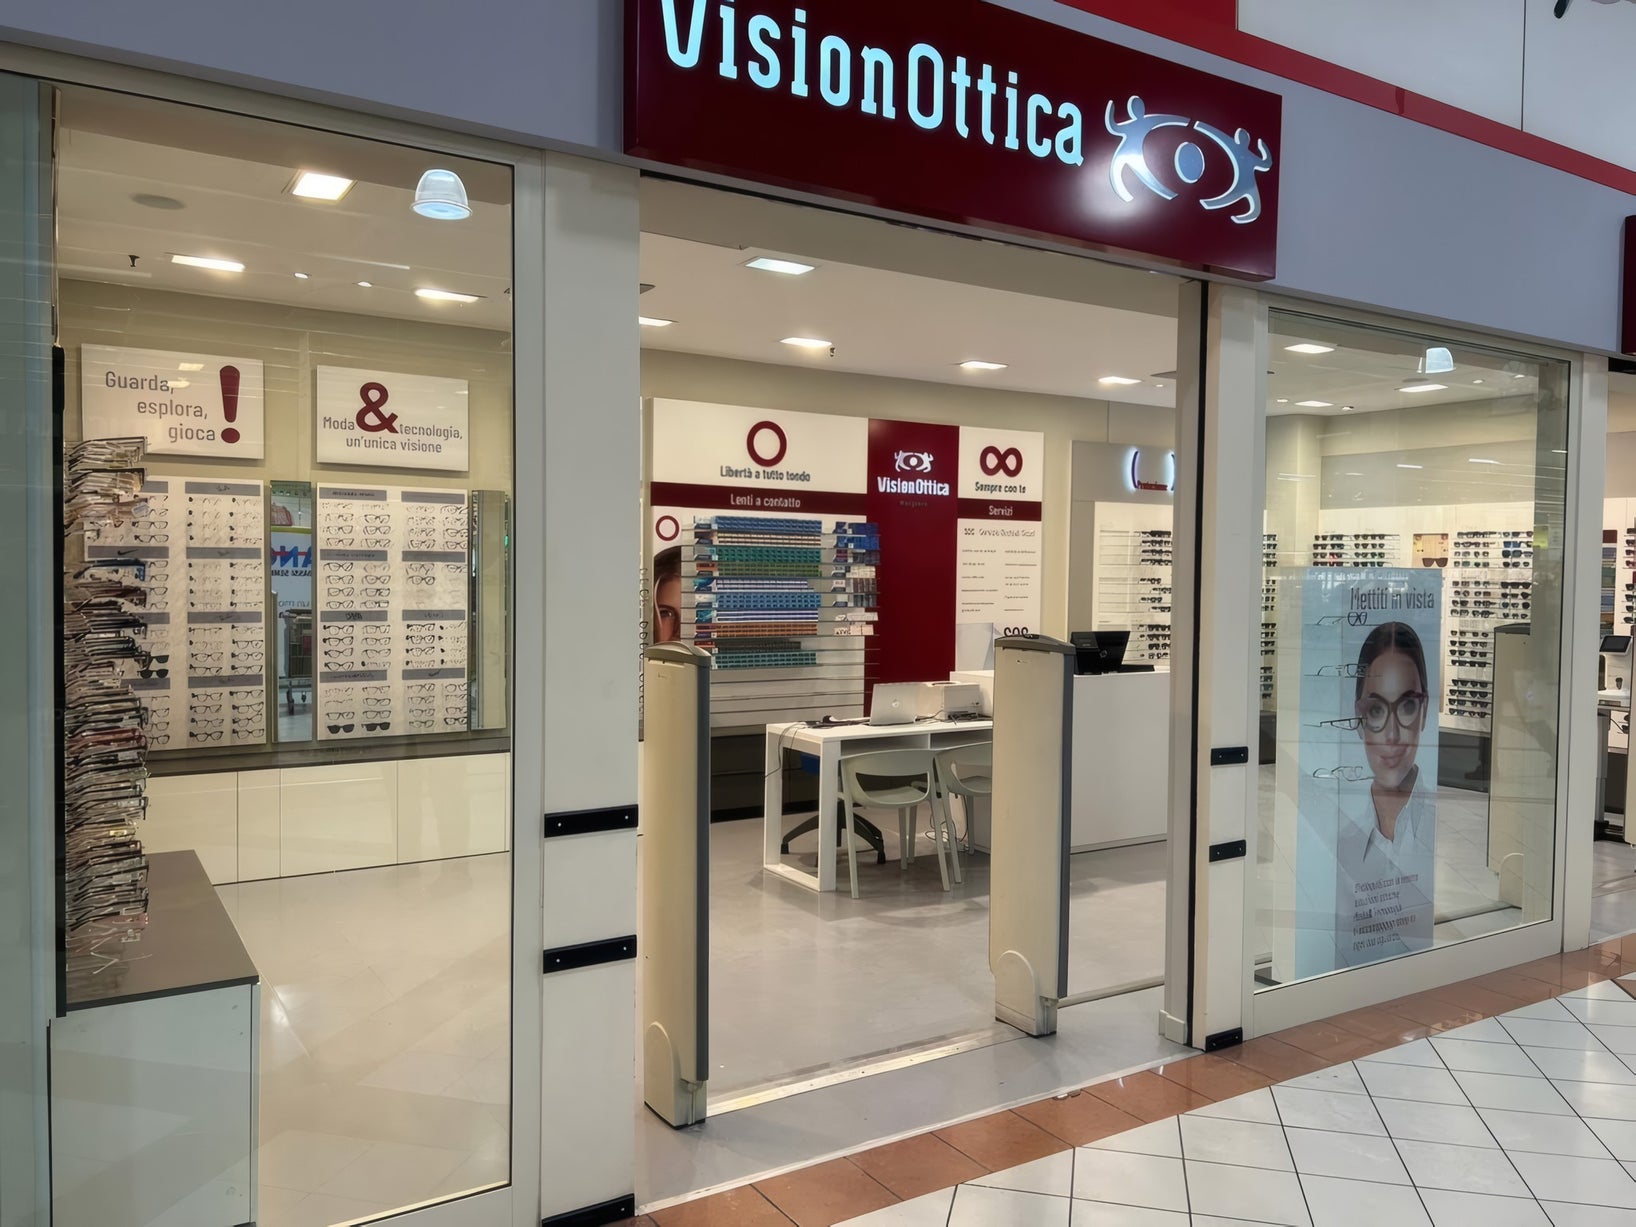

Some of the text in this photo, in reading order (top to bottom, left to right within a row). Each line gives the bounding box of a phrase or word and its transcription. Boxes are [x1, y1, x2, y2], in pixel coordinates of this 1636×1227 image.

[661, 0, 1084, 167] VisionOttica
[105, 371, 174, 394] Guarda,
[137, 400, 208, 419] esplora,
[356, 382, 399, 433] &
[323, 416, 355, 431] Moda
[400, 423, 463, 440] tecnologia,
[346, 436, 442, 453] un'unica visione
[720, 465, 811, 482] Libertà a tutto tondo
[877, 476, 950, 496] VisionOttica
[975, 481, 1002, 494] Sempre
[730, 493, 801, 508] Lenti a contatto
[988, 505, 1013, 516] Servizi
[1350, 587, 1388, 610] Mettiti
[1405, 587, 1434, 609] vista
